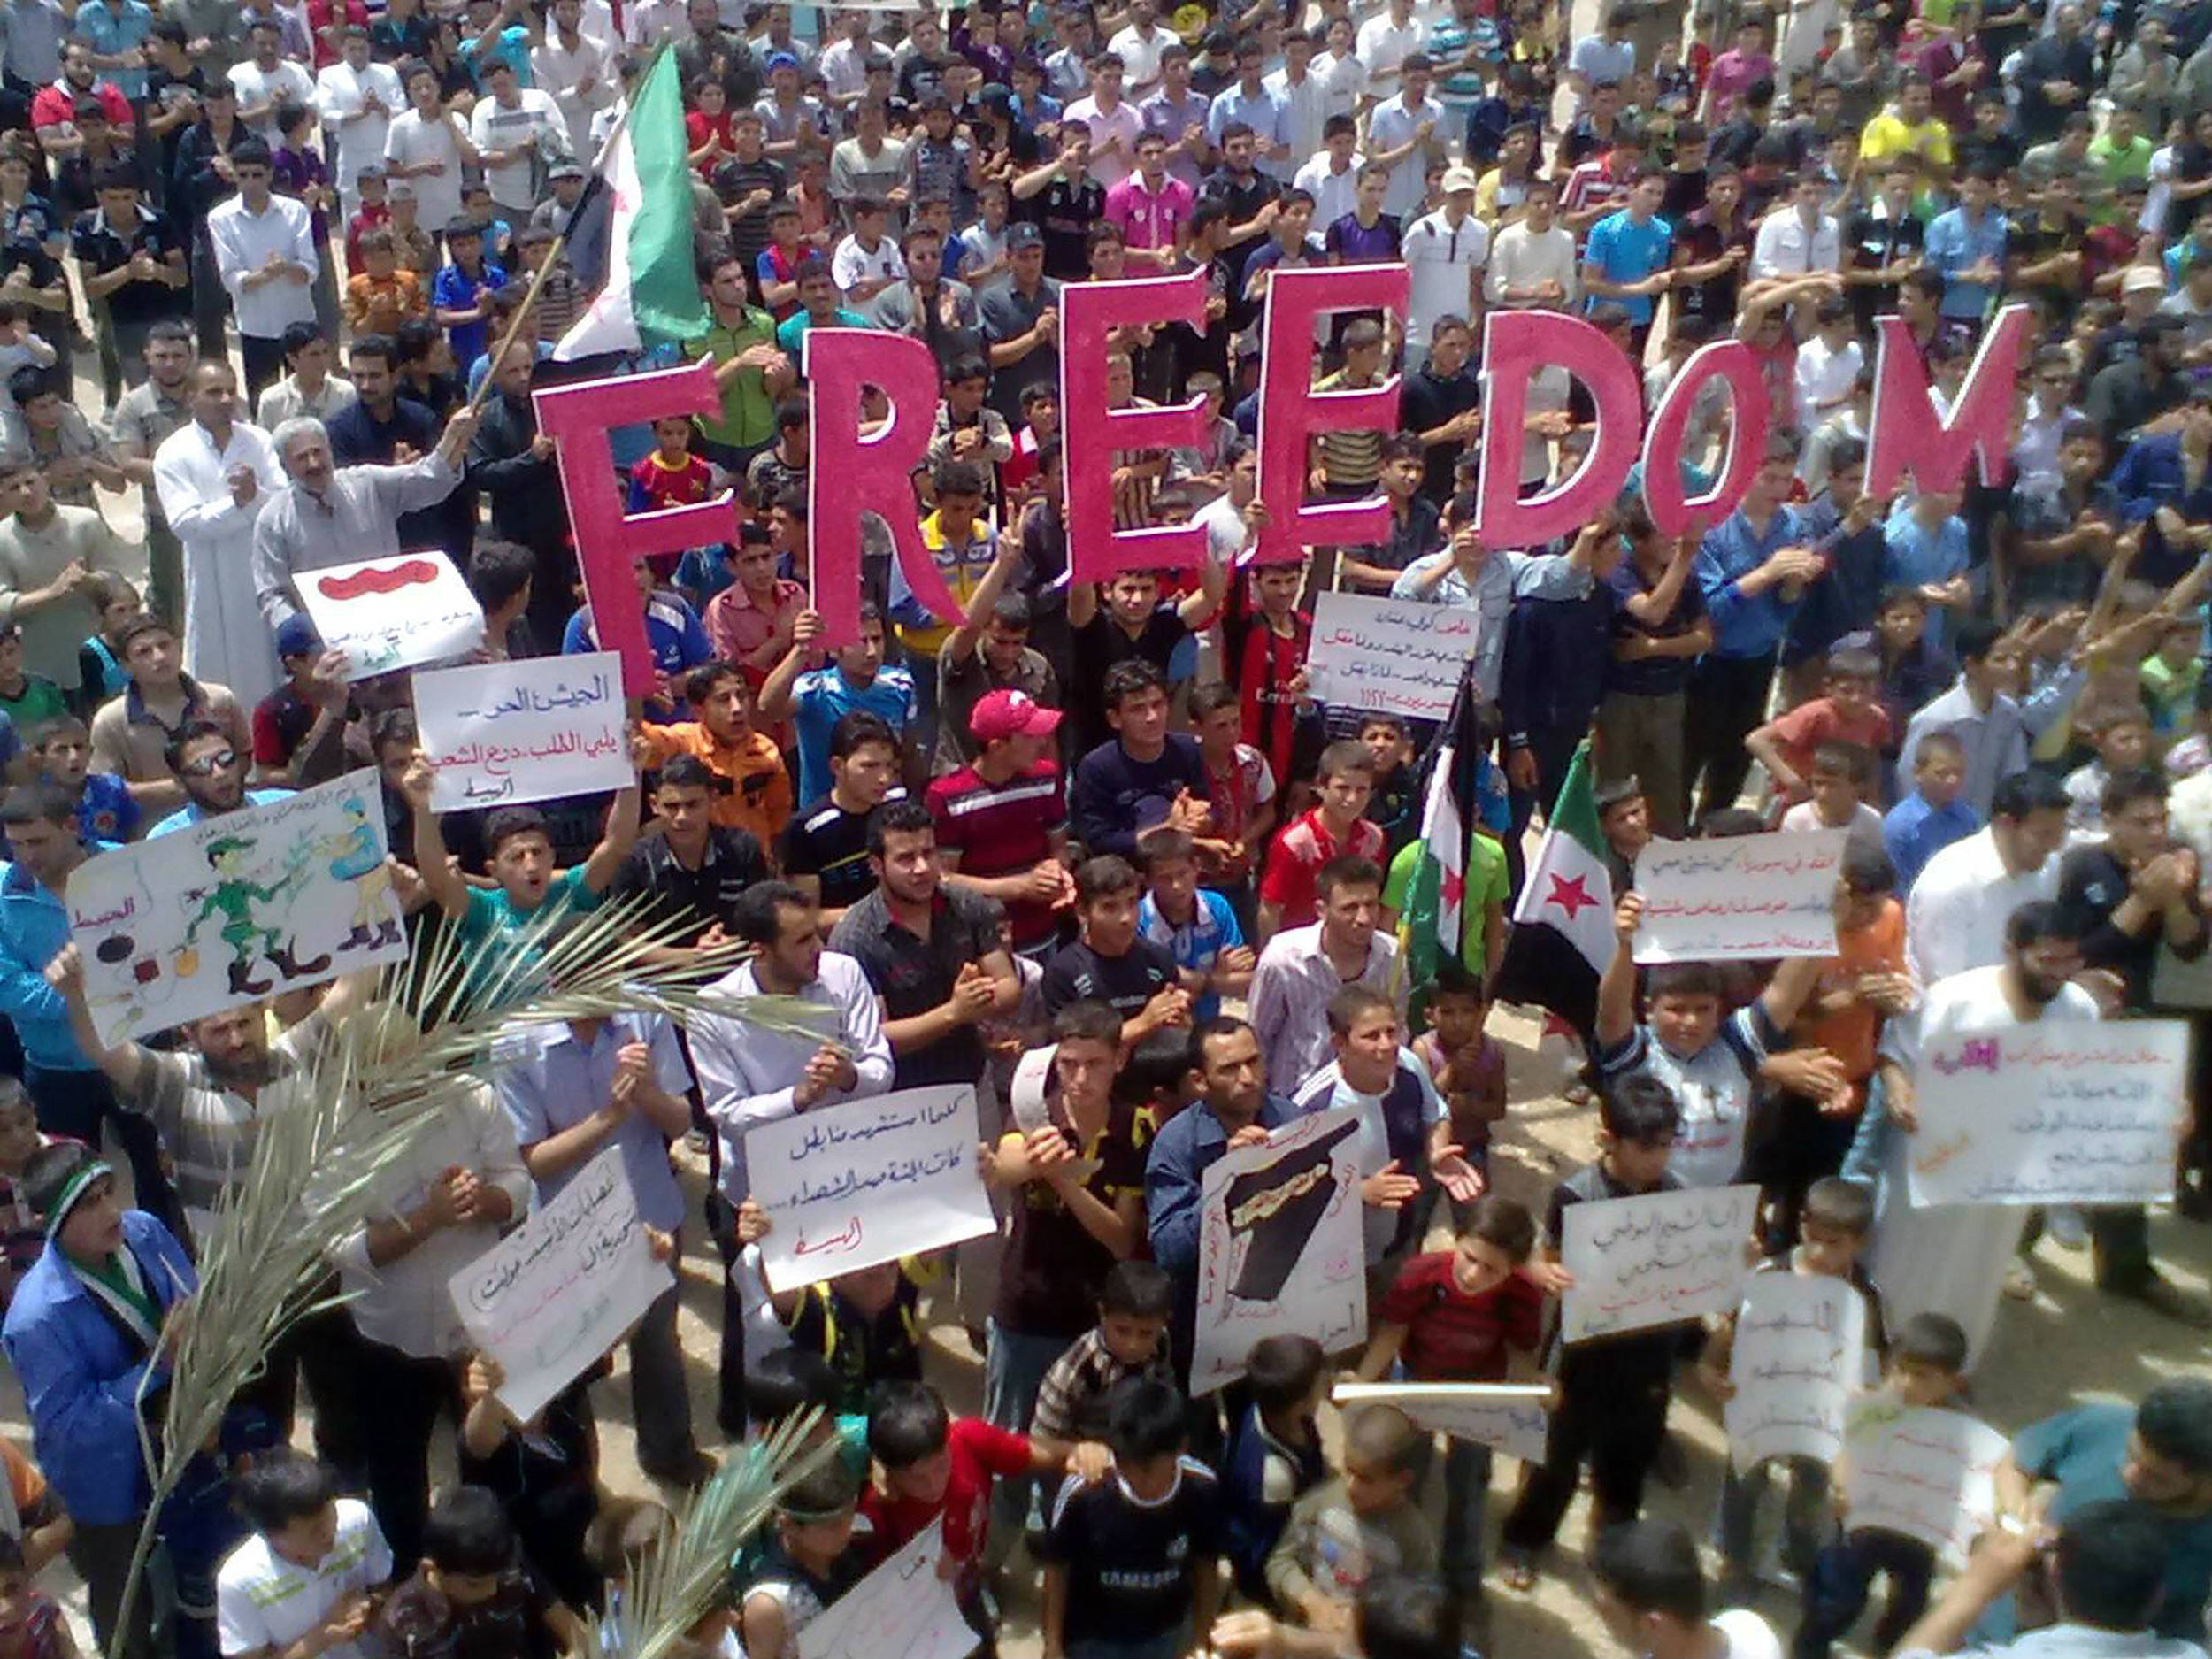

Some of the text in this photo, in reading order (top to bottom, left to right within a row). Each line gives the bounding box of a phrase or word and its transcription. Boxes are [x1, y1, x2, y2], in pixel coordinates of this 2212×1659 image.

[531, 262, 2030, 699] FREEDOM
[532, 674, 610, 711] الجيش
[927, 1092, 969, 1125] كلما
